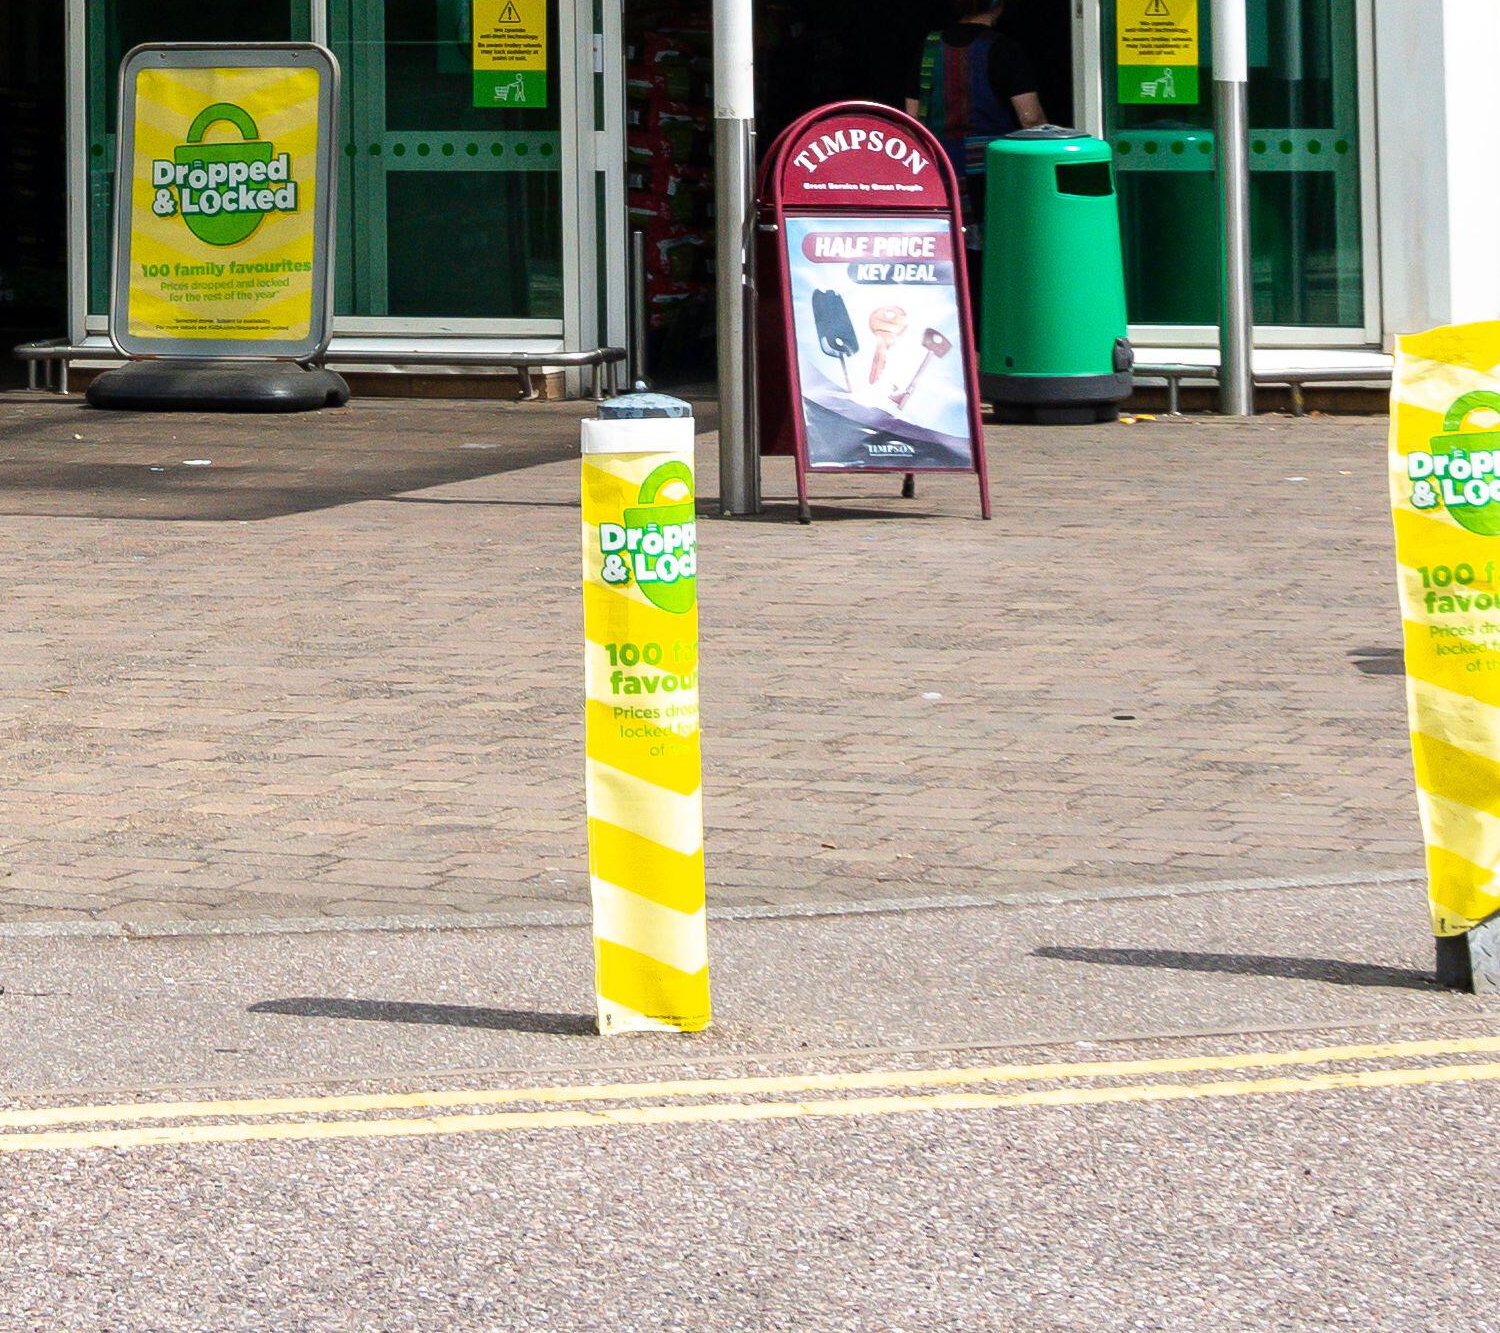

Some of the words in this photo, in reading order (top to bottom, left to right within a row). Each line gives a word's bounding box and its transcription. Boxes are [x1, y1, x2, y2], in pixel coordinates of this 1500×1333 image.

[793, 129, 930, 175] TIMPSON
[153, 153, 289, 189] Dropped
[153, 188, 177, 215] &
[814, 236, 869, 258] HALF
[872, 236, 936, 258] PRICE
[142, 263, 170, 277] 100
[174, 261, 225, 277] family
[229, 259, 312, 275] favourites
[856, 263, 891, 281] KEY
[892, 263, 937, 282] DEAL
[160, 281, 189, 291] Prices
[191, 280, 234, 292] dropped
[236, 278, 255, 288] and
[256, 277, 290, 288] locked
[169, 293, 184, 302] for
[186, 292, 201, 302] the
[203, 292, 222, 301] rest
[224, 291, 235, 300] of
[236, 290, 252, 300] the
[1411, 480, 1438, 509] &
[600, 519, 697, 555] Dropp
[601, 554, 629, 584] &
[1417, 562, 1475, 588] 100
[1430, 623, 1475, 638] Prices
[605, 642, 663, 668] 100
[673, 639, 698, 663] fa
[1436, 638, 1487, 656] locked
[1466, 659, 1481, 673] of
[613, 706, 661, 719] Prices
[620, 725, 672, 738] locked
[650, 744, 664, 756] of
